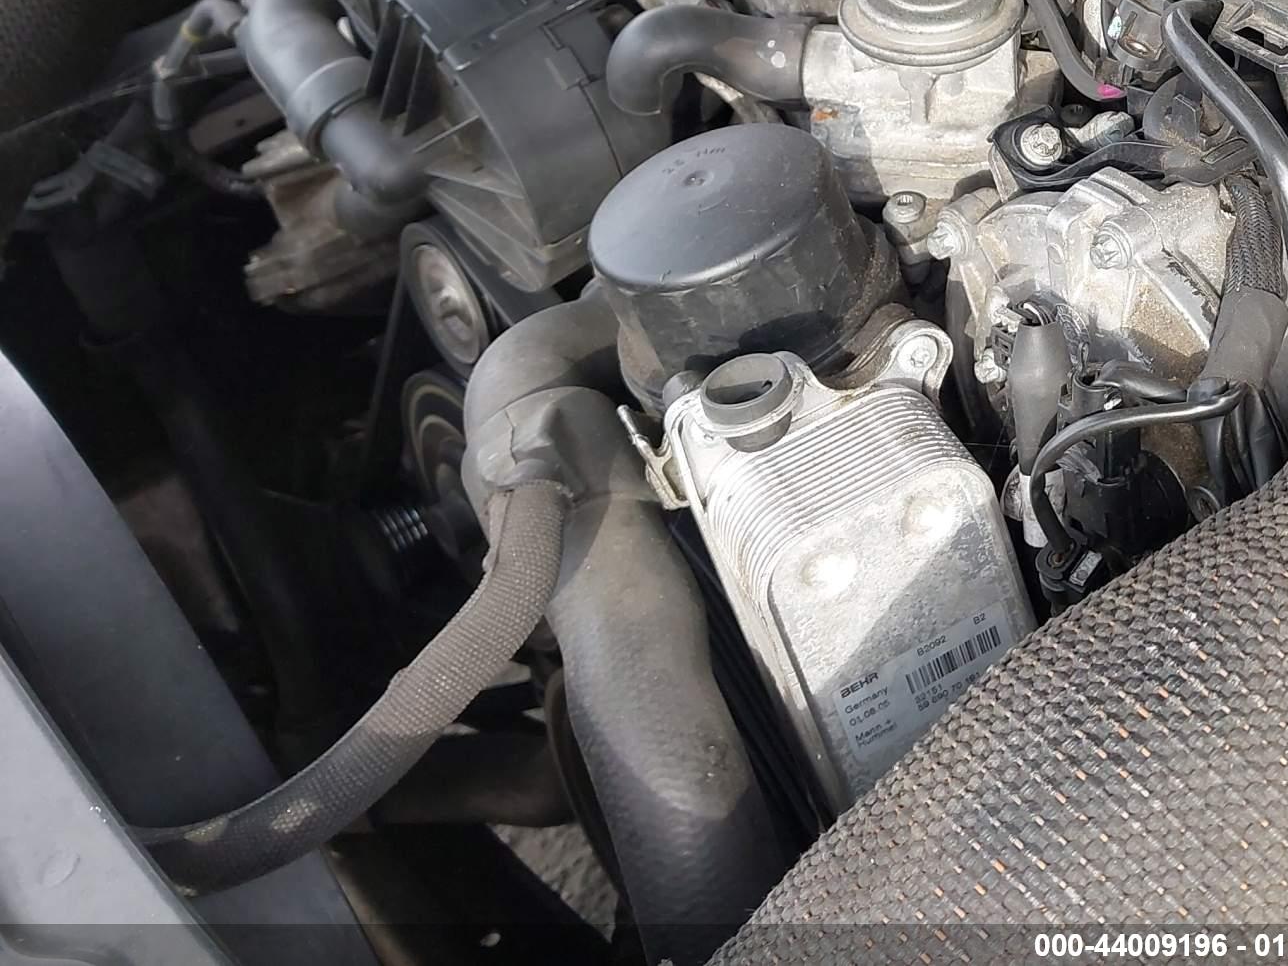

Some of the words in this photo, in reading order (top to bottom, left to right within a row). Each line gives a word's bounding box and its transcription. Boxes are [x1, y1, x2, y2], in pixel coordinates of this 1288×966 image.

[917, 635, 947, 656] B2092
[973, 613, 986, 625] B2
[840, 672, 879, 699] BEHR
[844, 685, 888, 714] Germany
[855, 724, 882, 742] Mann
